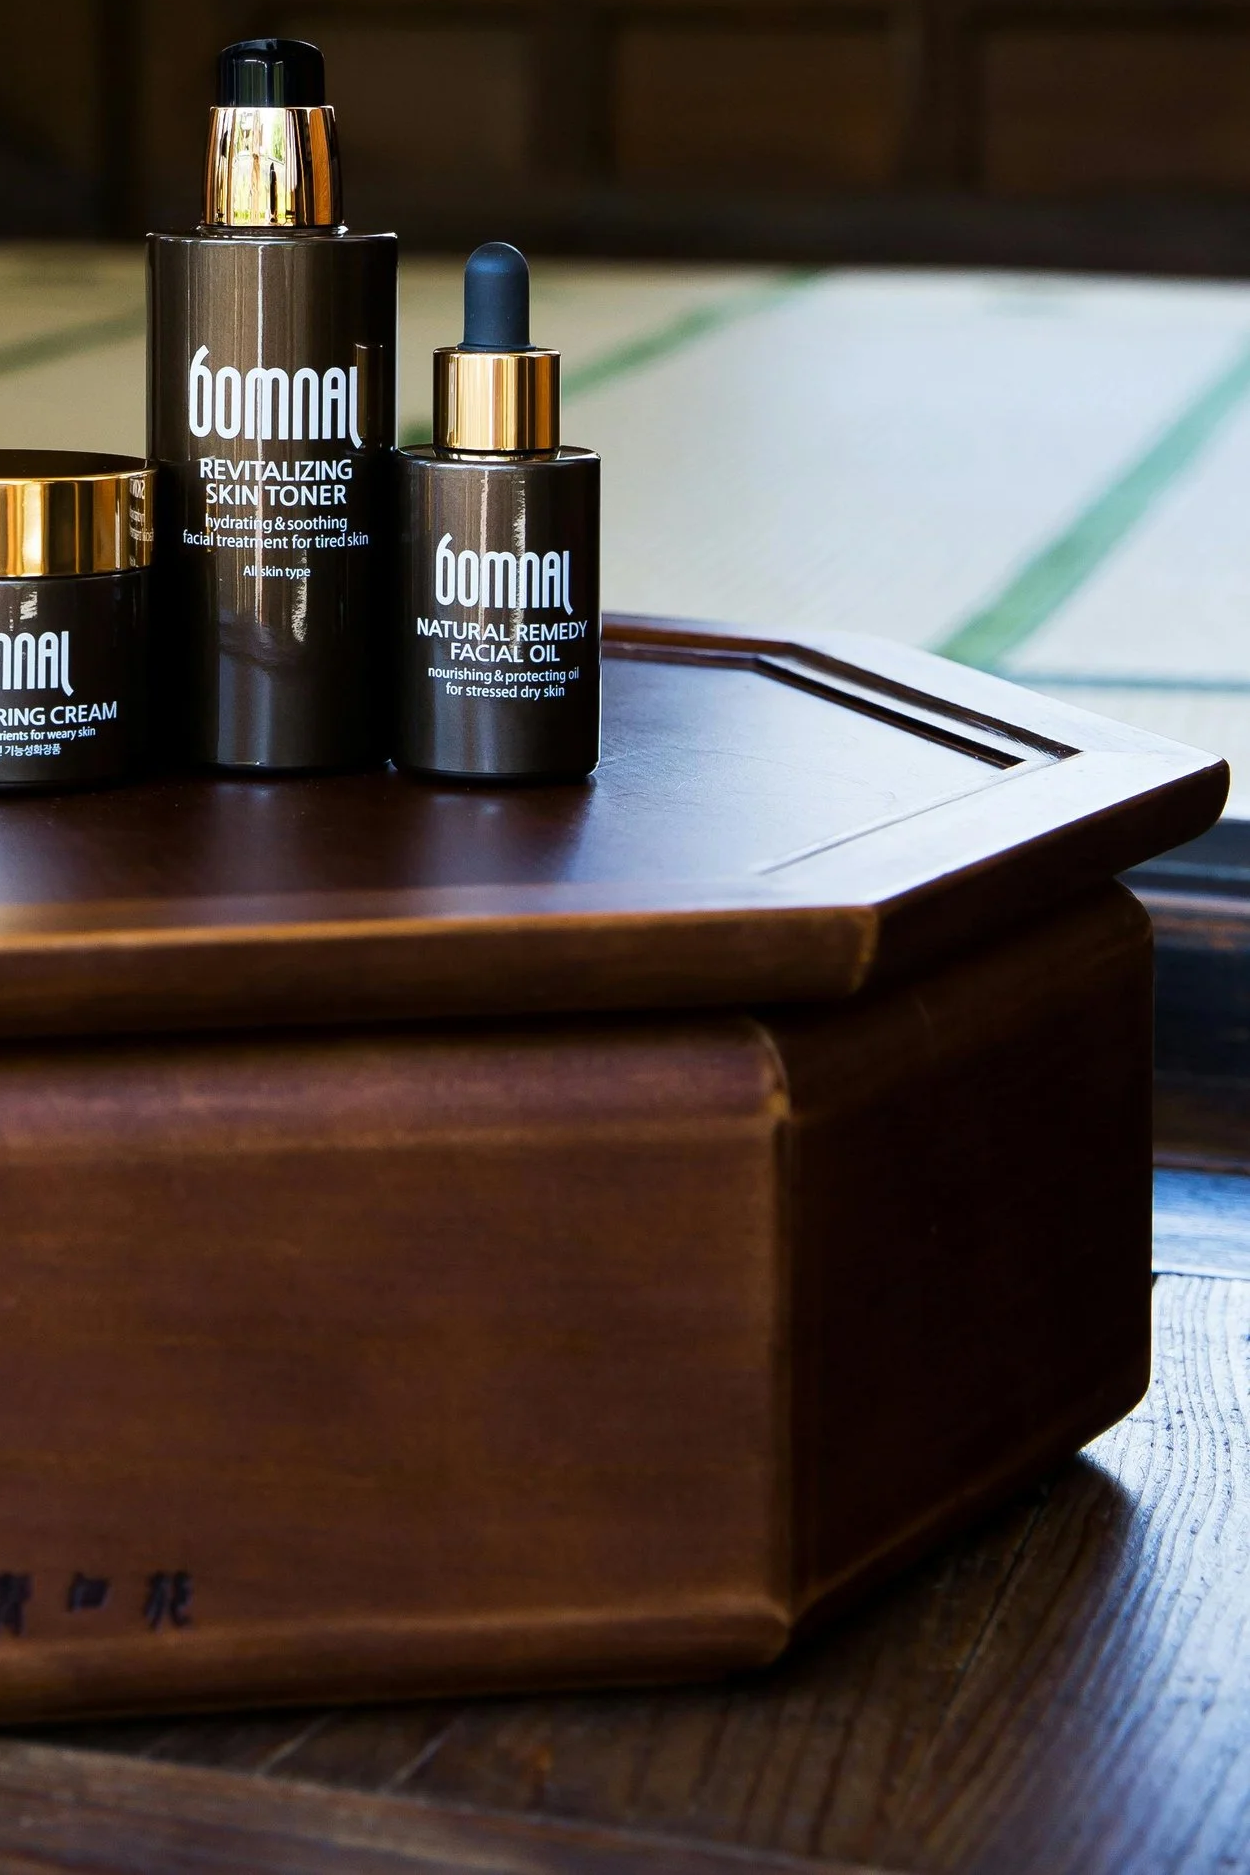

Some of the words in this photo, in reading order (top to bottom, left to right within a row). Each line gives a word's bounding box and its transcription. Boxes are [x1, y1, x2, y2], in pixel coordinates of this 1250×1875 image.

[200, 459, 353, 482] REVITALIZING
[206, 484, 258, 506] SKIN
[264, 484, 347, 507] TONER
[205, 514, 272, 533] hydrating
[275, 517, 286, 530] &
[287, 515, 348, 532] soothing
[183, 529, 214, 546] facial
[217, 533, 288, 549] treatment
[292, 532, 314, 549] for
[315, 532, 345, 548] tired
[347, 531, 369, 546] skin
[243, 565, 257, 577] All
[260, 565, 283, 577] skin
[285, 566, 311, 579] type
[417, 617, 510, 642] NATURAL
[516, 620, 587, 642] REMEDY
[450, 642, 524, 663] FACIAL
[529, 644, 560, 663] OIL
[428, 667, 492, 684] nourishing
[494, 670, 504, 682] &
[505, 668, 566, 685] protecting
[568, 666, 580, 679] oil
[446, 682, 463, 696] for
[465, 685, 518, 698] stressed
[520, 685, 541, 701] dry
[543, 684, 565, 697] skin
[50, 701, 117, 723] CREAM
[30, 728, 46, 741] for
[47, 729, 77, 741] weary
[77, 726, 96, 738] skin
[5, 743, 62, 756] 기능성화장품
